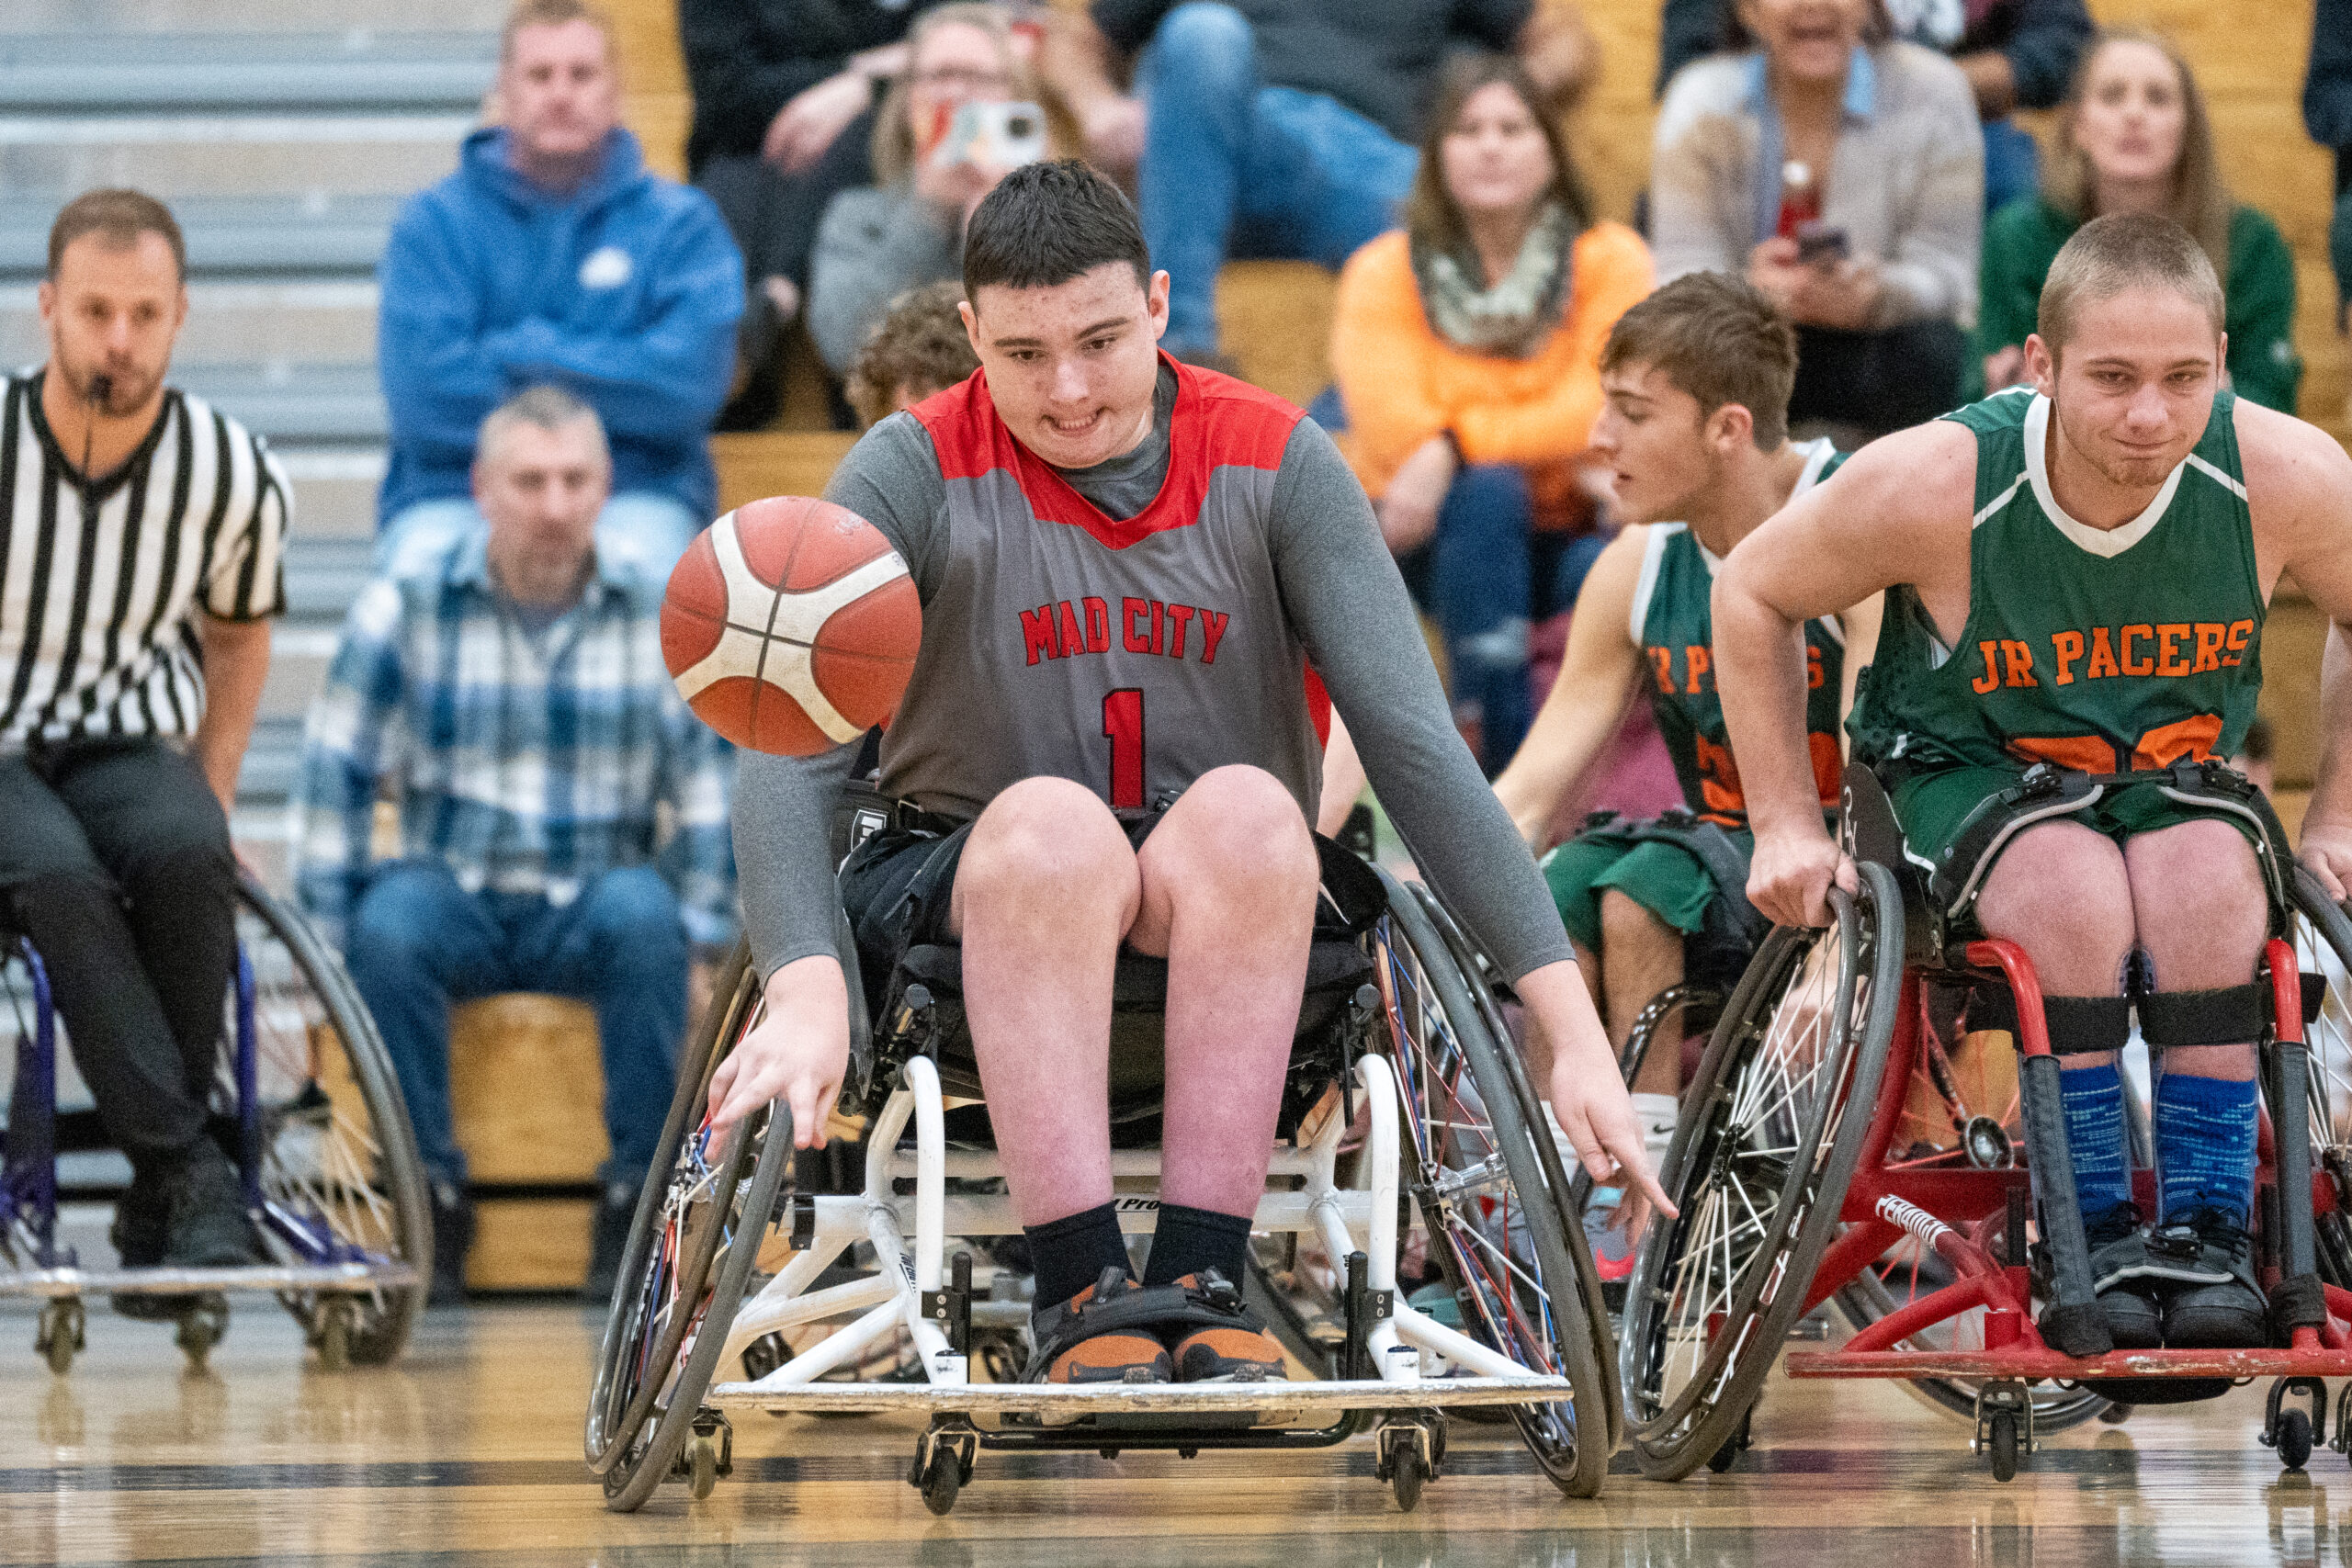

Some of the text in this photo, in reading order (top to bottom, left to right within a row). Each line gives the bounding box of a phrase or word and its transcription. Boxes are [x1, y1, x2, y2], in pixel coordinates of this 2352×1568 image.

[1018, 596, 1230, 666] MAD CITY
[1972, 618, 2255, 694] JR PACERS
[1102, 687, 1146, 808] 1
[1121, 1198, 1161, 1210] Pro
